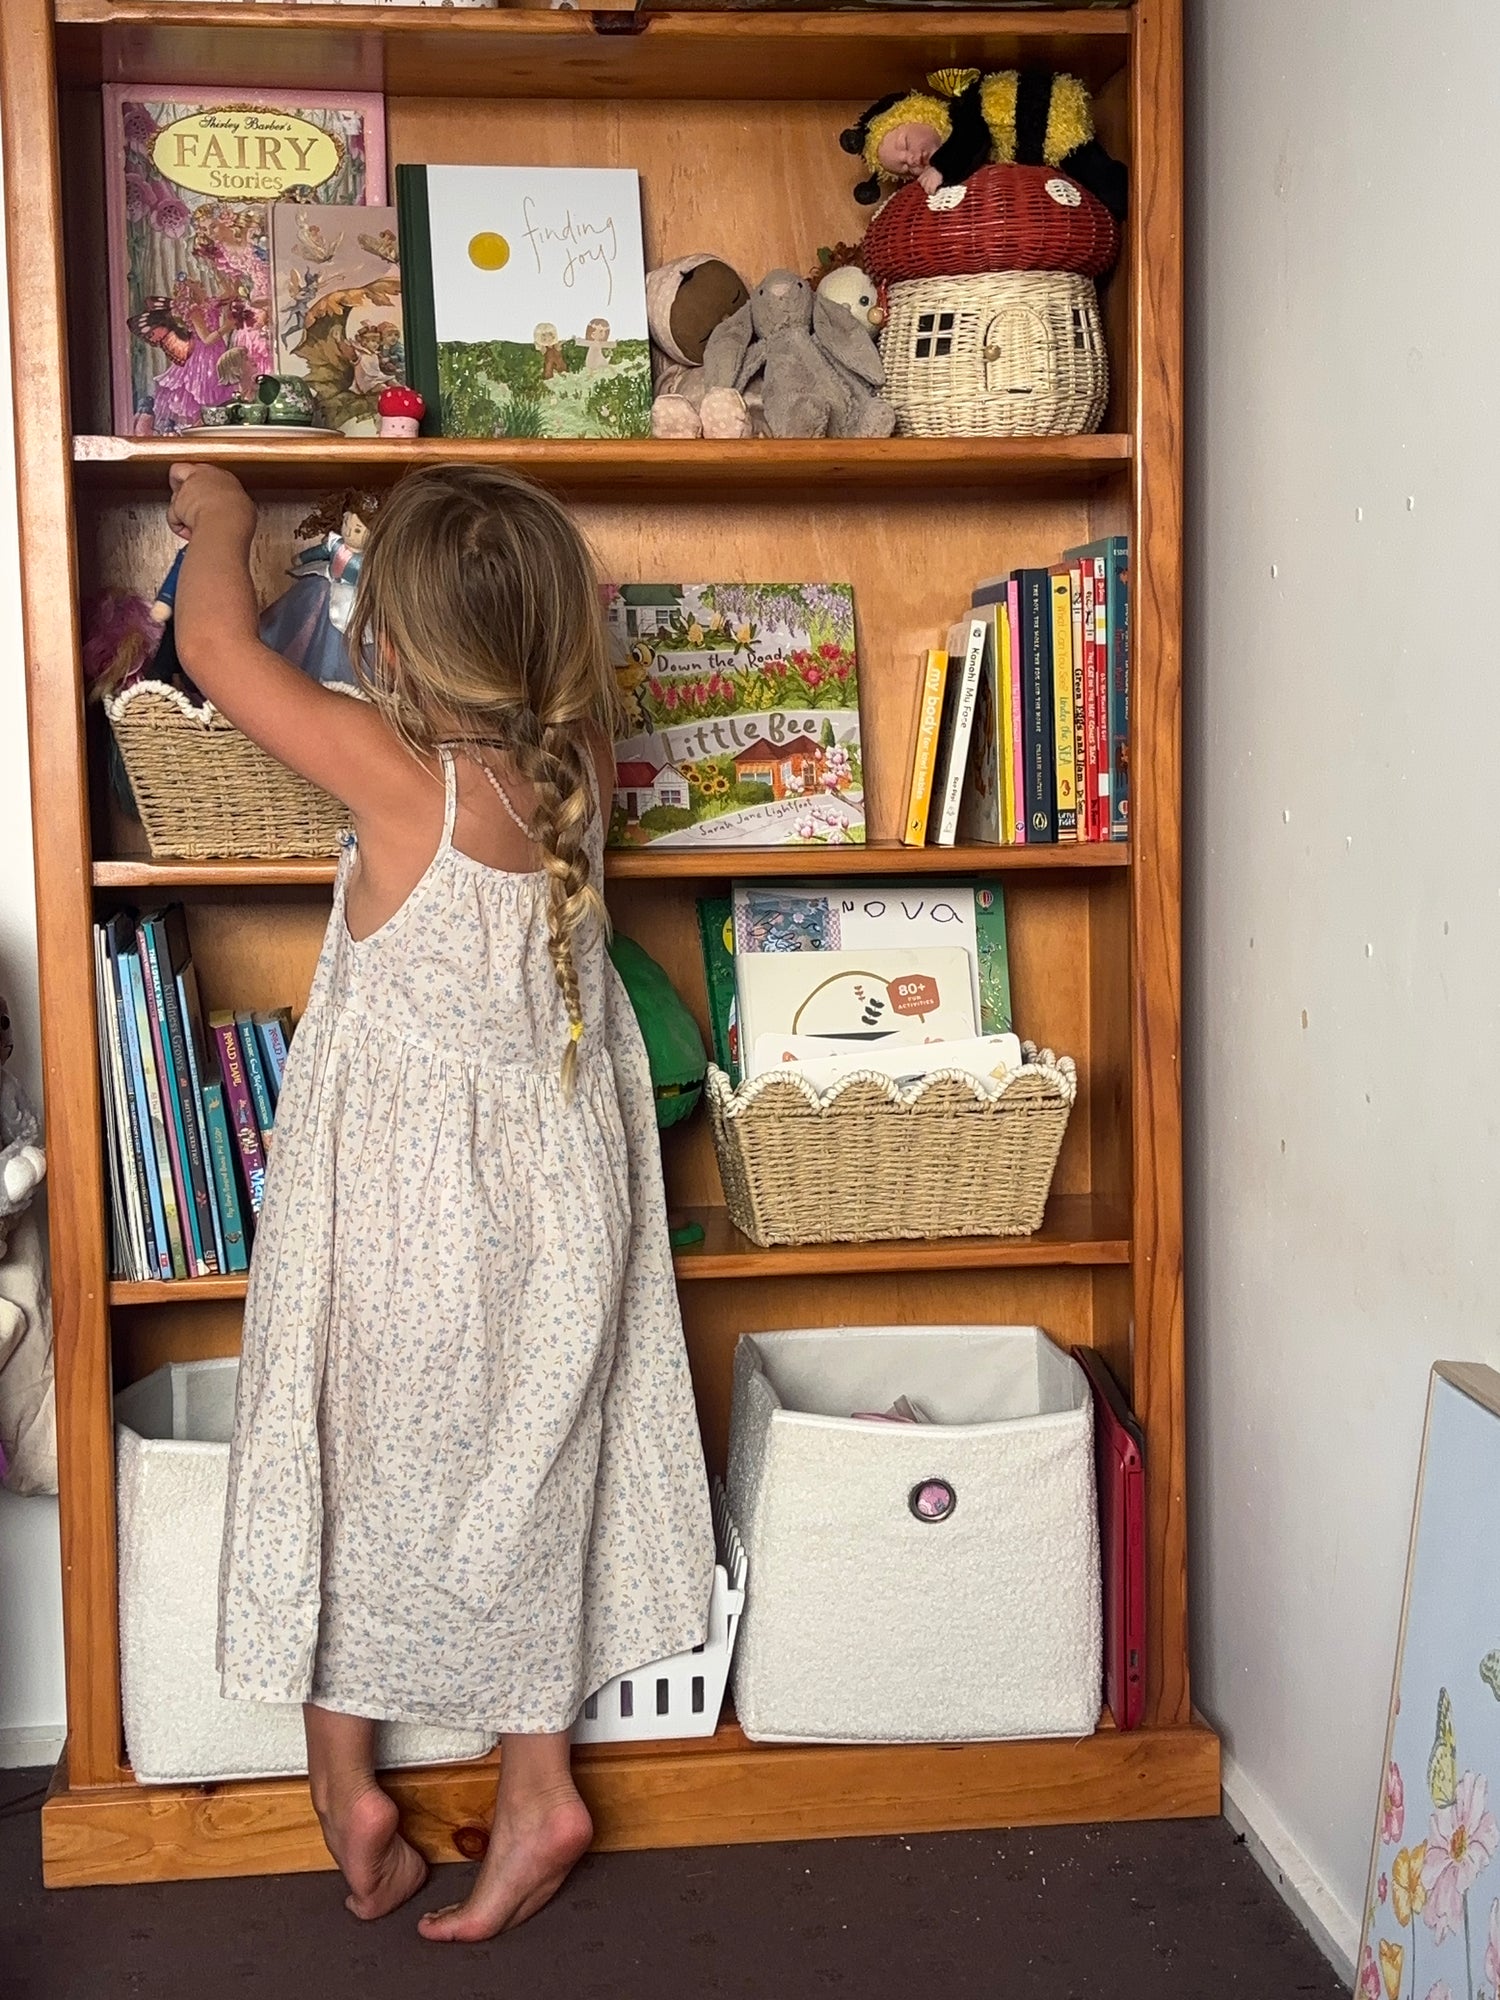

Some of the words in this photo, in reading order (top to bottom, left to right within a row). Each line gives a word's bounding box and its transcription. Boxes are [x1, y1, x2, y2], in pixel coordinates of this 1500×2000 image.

[199, 116, 240, 133] Shirley
[244, 116, 292, 131] Barber's
[173, 133, 319, 171] FAIRY
[209, 169, 283, 190] Stories
[522, 196, 617, 274] finding
[563, 244, 613, 306] joy
[657, 655, 702, 673] Down
[708, 654, 735, 668] the
[966, 647, 980, 683] Kanohi
[926, 669, 941, 692] my
[1074, 668, 1083, 699] Green
[963, 687, 975, 703] My
[922, 695, 941, 735] body
[960, 705, 973, 729] Face
[1075, 706, 1085, 731] Eggs
[661, 718, 760, 765] Little
[768, 712, 818, 744] Bee
[923, 737, 932, 748] for
[1076, 734, 1085, 755] and
[1058, 745, 1072, 766] SEA
[1077, 757, 1085, 782] Ham
[915, 771, 927, 800] babies
[699, 821, 734, 836] Sarah
[736, 812, 762, 825] Jane
[765, 798, 813, 819] Lightfoot
[148, 948, 156, 963] THE
[151, 965, 161, 991] LORAX
[898, 982, 926, 996] 80+
[898, 998, 935, 1010] ACTIVITIES
[163, 984, 179, 1029] Kindness
[171, 1032, 185, 1071] Grows
[223, 1031, 237, 1060] ROALD
[229, 1062, 242, 1087] DAHL
[245, 1037, 255, 1057] CLASSIC
[258, 1095, 269, 1125] COLLECTION
[184, 1099, 192, 1123] BRITTA
